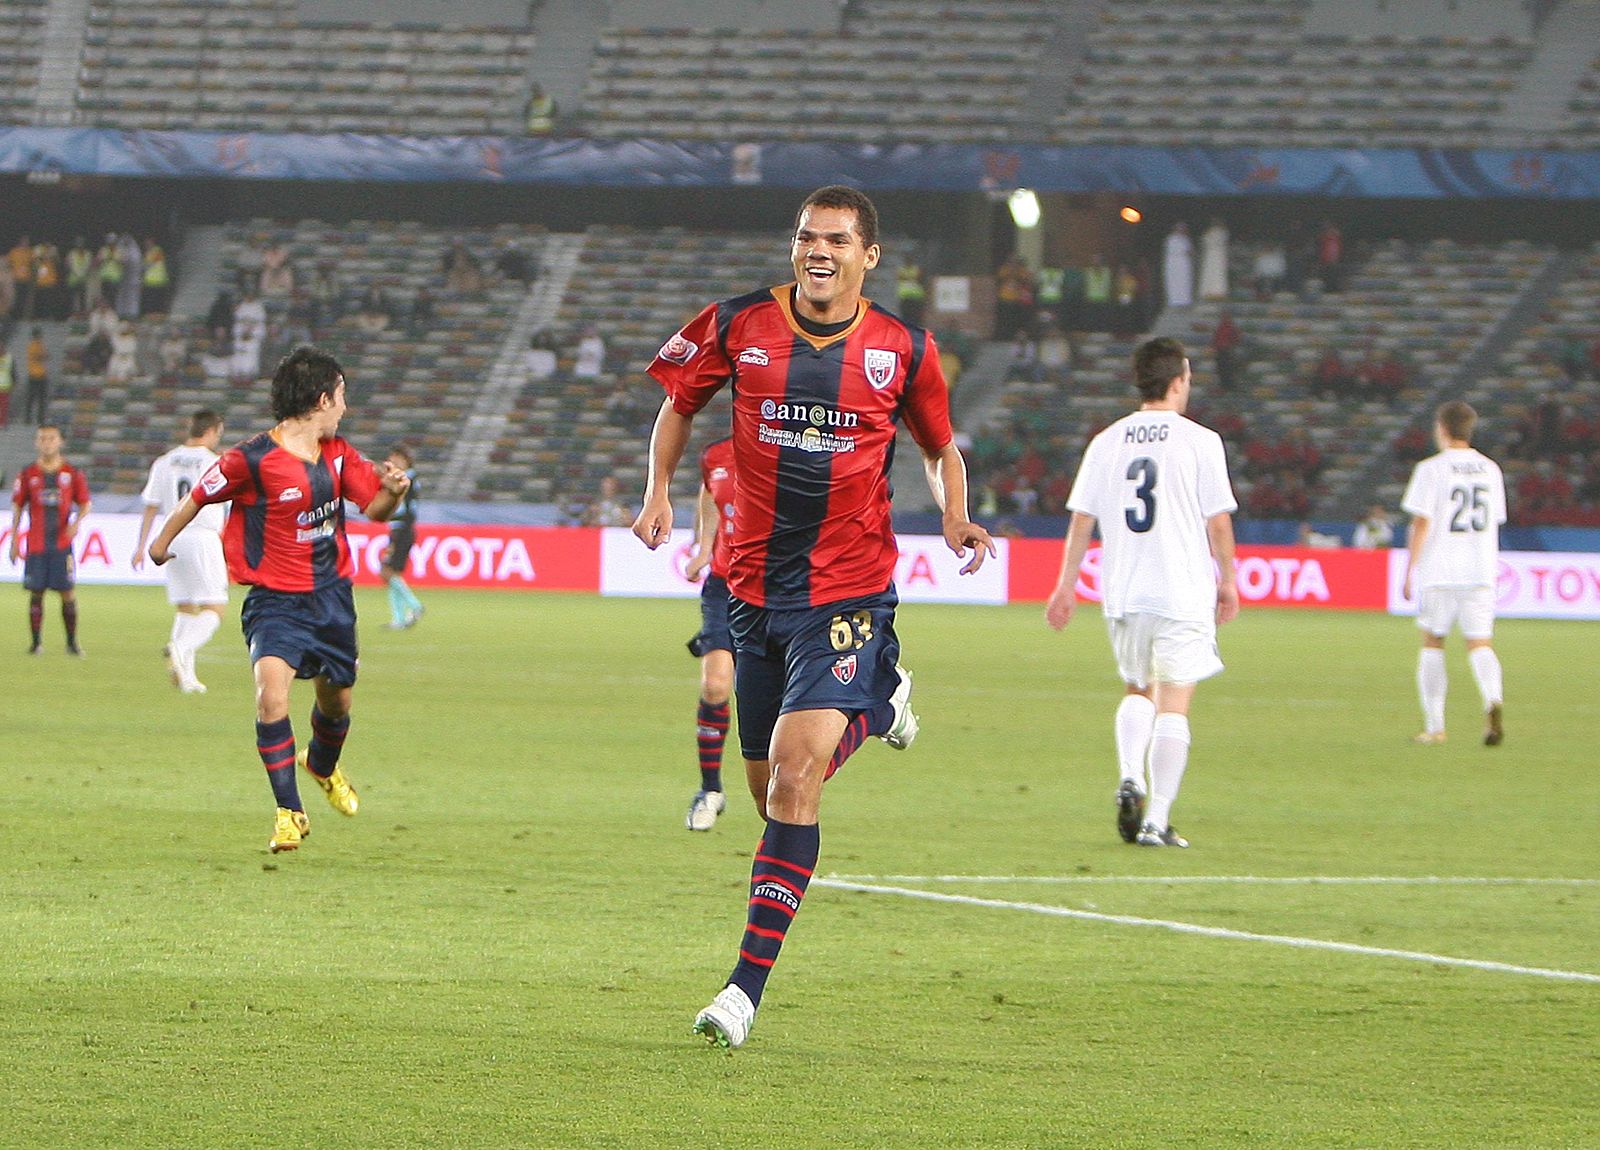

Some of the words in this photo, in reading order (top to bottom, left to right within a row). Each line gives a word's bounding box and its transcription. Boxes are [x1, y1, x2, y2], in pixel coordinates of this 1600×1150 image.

[760, 399, 858, 427] Cancun
[1125, 424, 1170, 443] HOGG
[1125, 456, 1158, 532] 3
[1450, 483, 1490, 532] 25
[829, 610, 874, 651] 63
